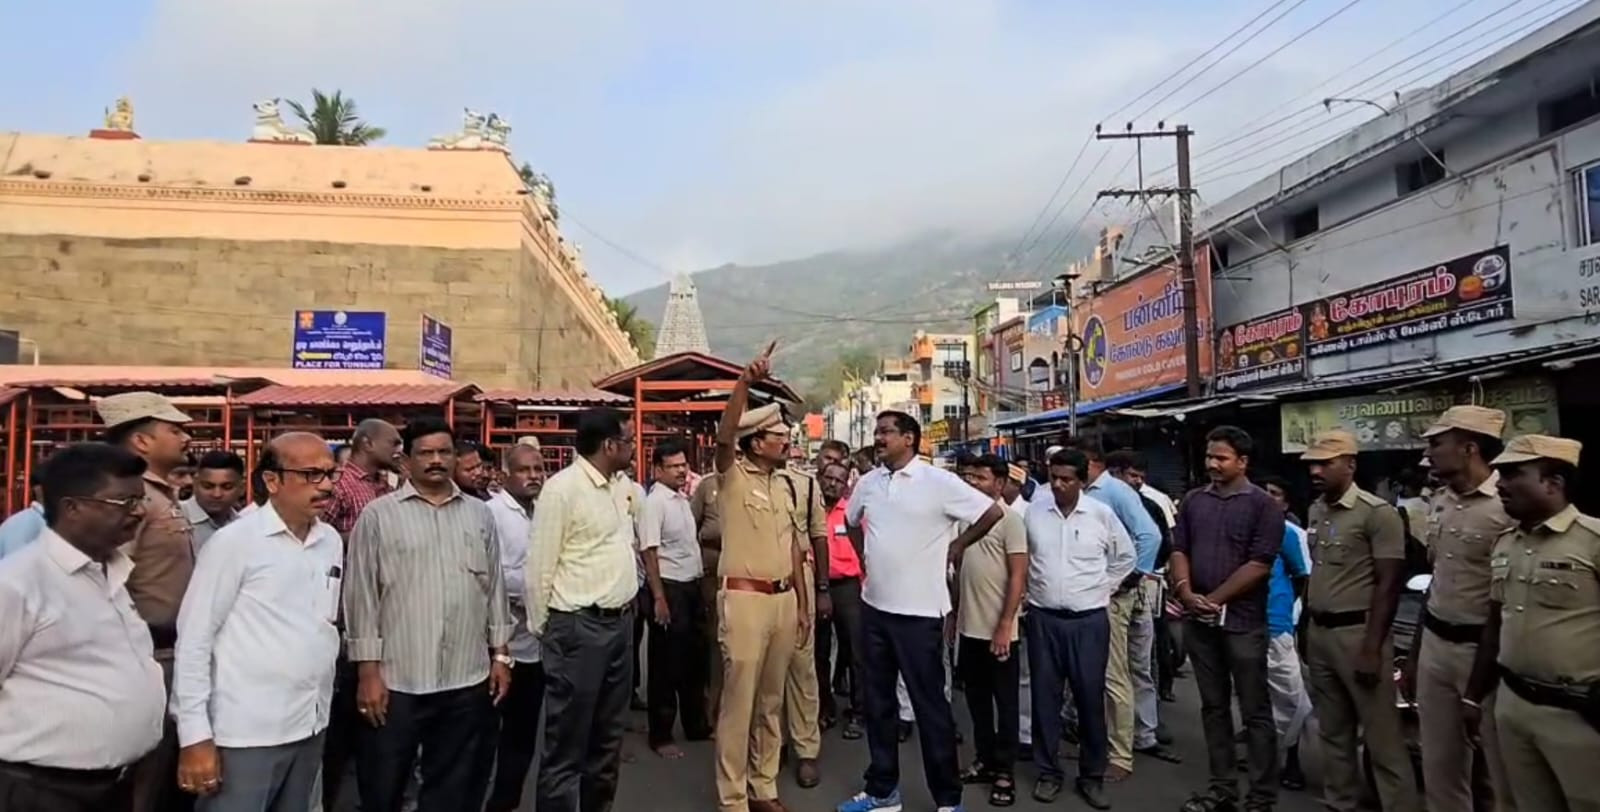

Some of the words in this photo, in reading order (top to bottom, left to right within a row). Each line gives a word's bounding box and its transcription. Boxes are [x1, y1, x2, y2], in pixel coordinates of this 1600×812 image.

[1329, 265, 1457, 322] கோபுரம்
[1234, 307, 1303, 347] கோபுரம்
[1388, 328, 1398, 341] &
[296, 361, 322, 369] PLACE
[324, 361, 340, 369] FOR
